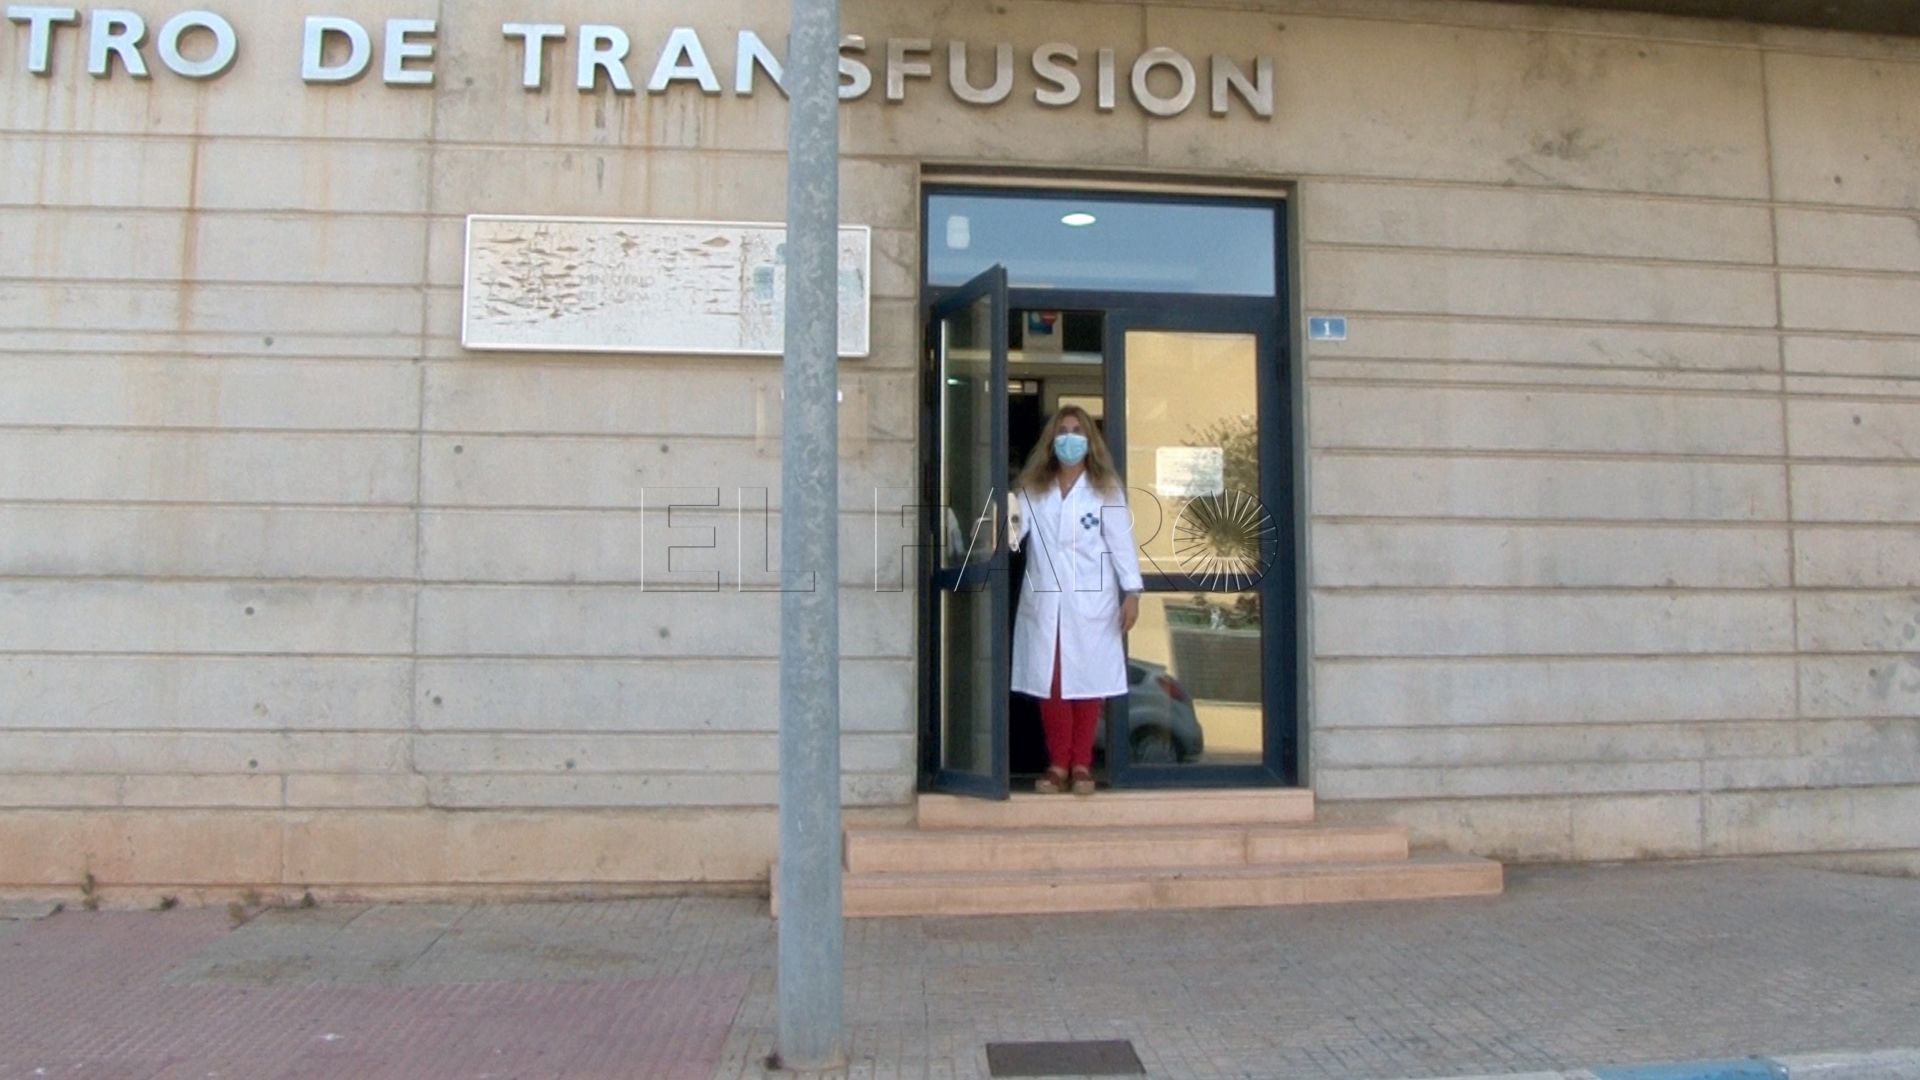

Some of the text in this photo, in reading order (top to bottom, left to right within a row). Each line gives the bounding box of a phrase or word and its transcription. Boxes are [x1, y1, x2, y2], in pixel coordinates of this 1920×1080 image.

[8, 5, 238, 80] TRO
[302, 16, 437, 86] DE
[1323, 320, 1330, 336] 1
